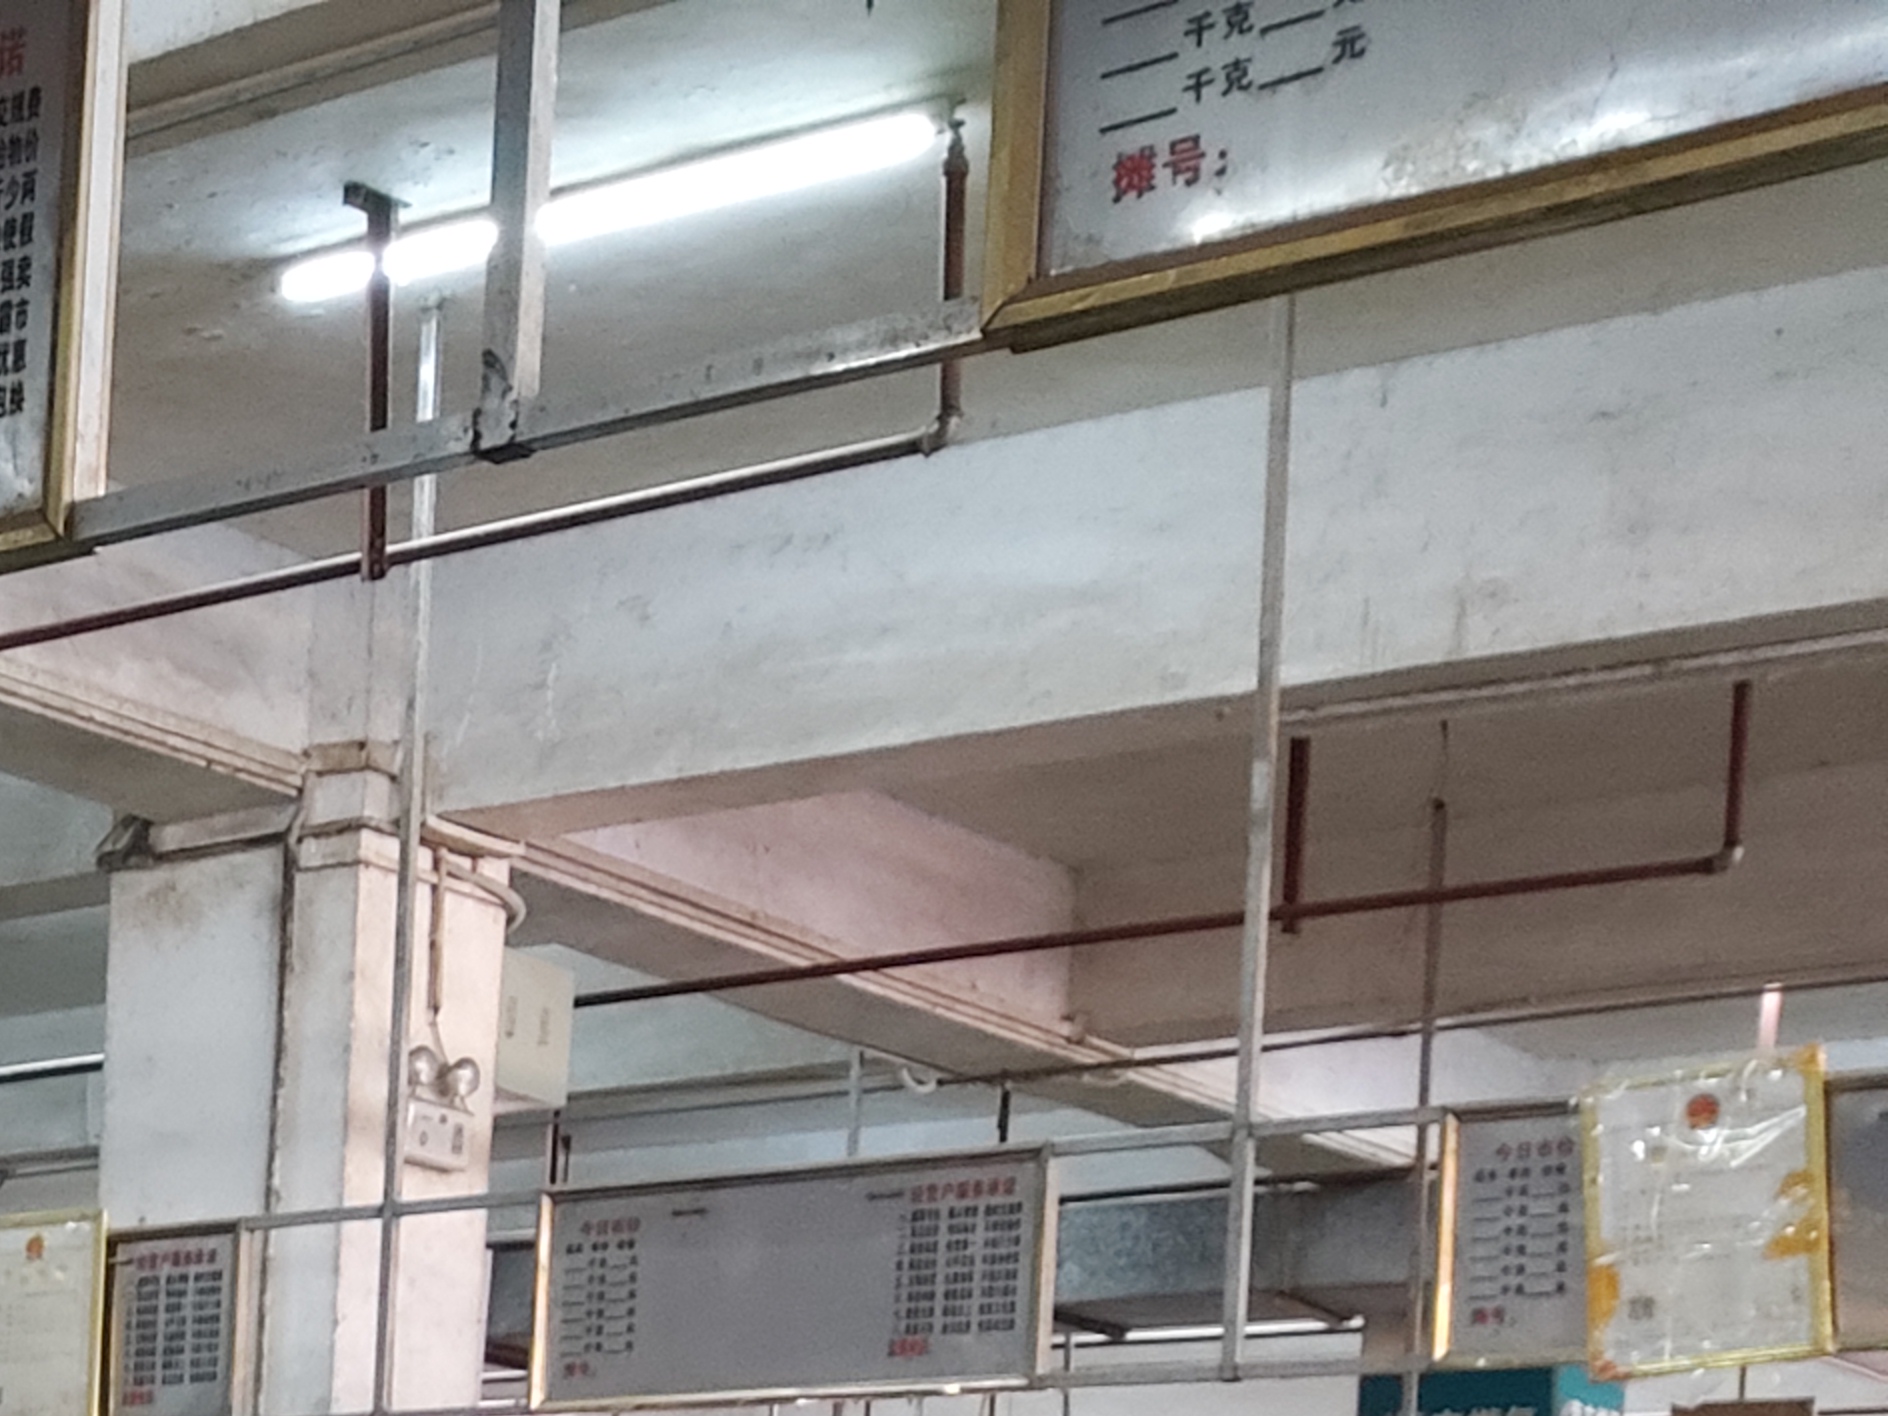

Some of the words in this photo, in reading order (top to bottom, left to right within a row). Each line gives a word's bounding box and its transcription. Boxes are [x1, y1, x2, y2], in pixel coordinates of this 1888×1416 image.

[1183, 0, 1254, 48] 千克
[1181, 57, 1253, 103] 千克
[1332, 24, 1367, 65] 元
